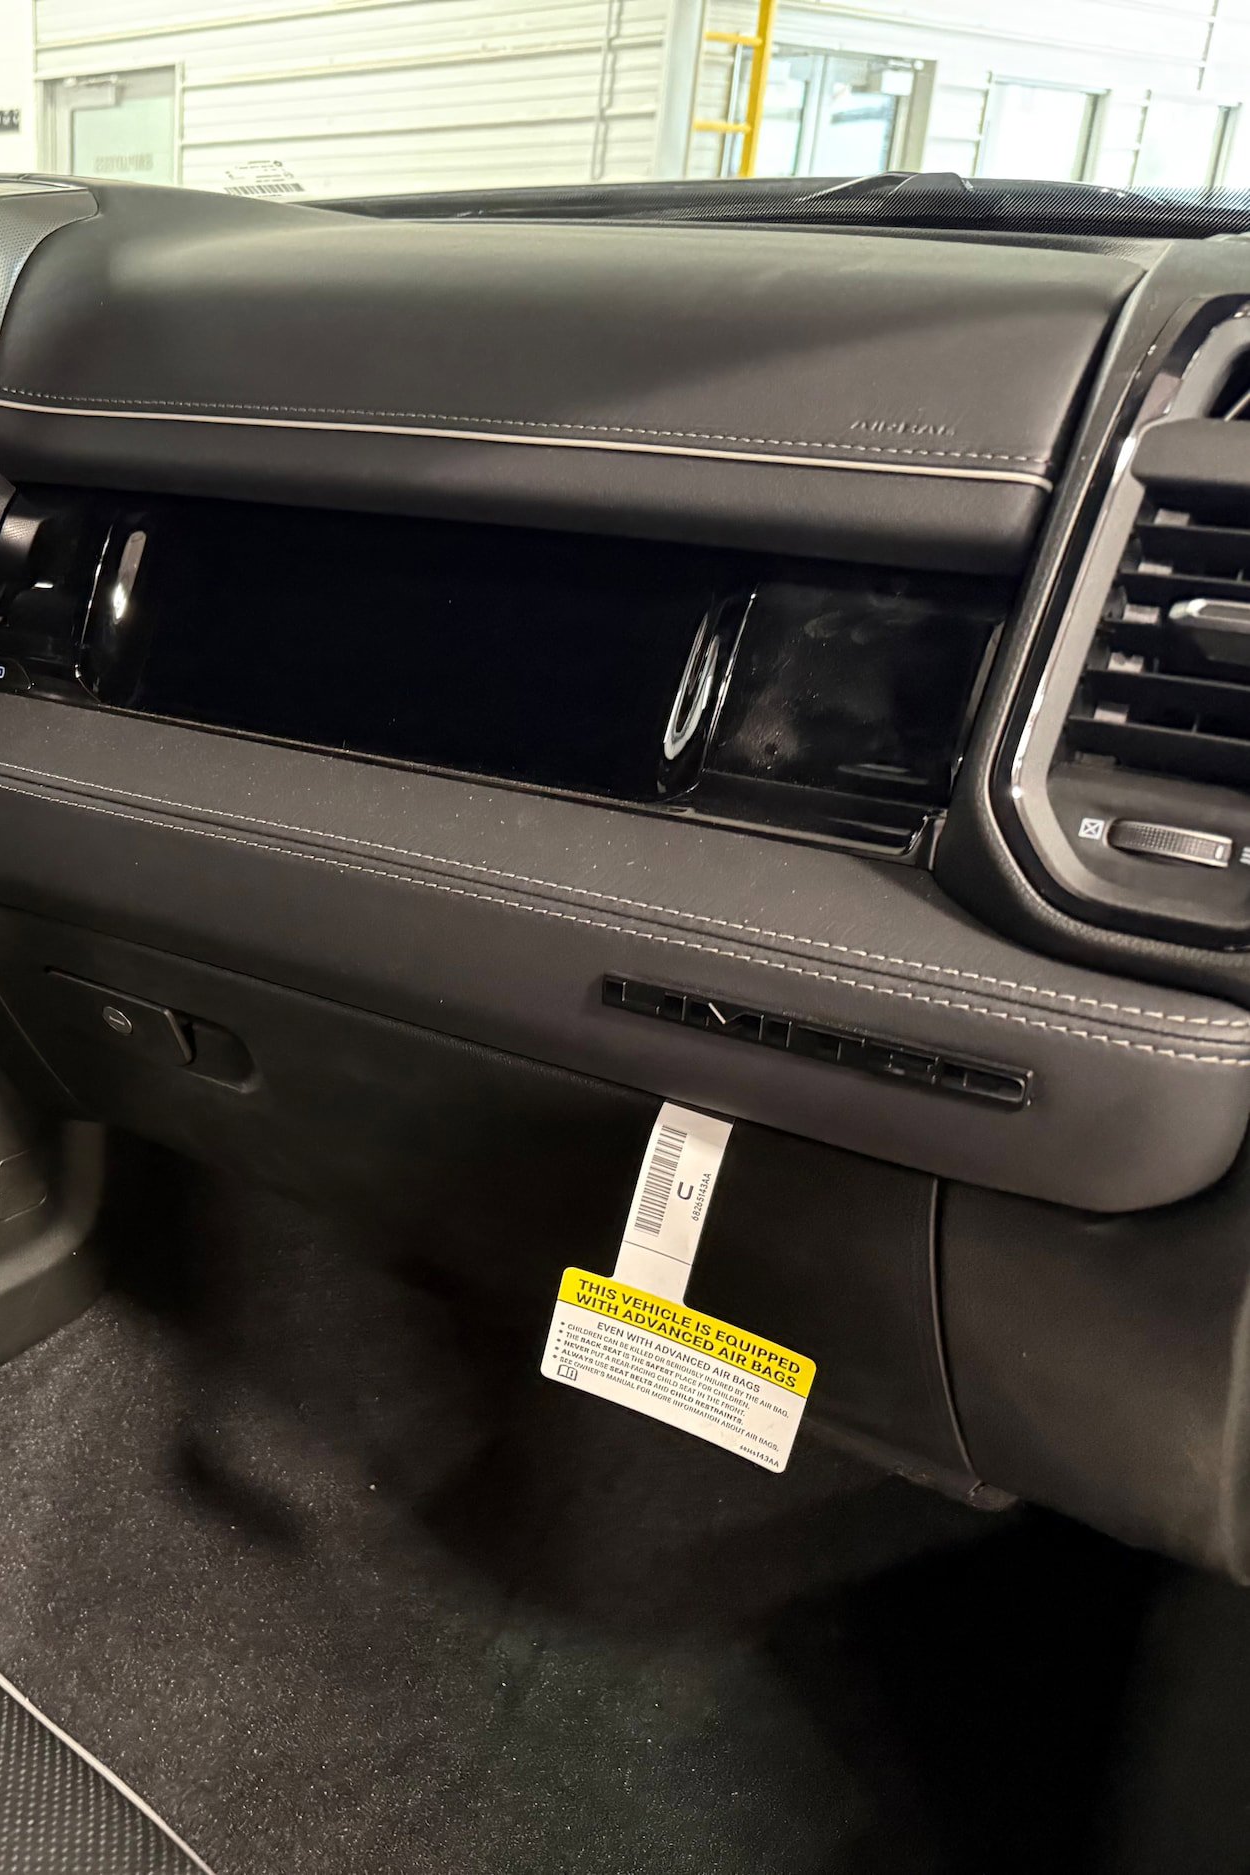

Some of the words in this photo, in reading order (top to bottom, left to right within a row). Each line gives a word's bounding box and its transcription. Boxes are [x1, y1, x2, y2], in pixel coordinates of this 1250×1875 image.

[602, 973, 1035, 1110] LIMITED
[677, 1181, 694, 1200] U
[691, 1172, 712, 1222] 68265143AA
[576, 1291, 619, 1316] WITH
[621, 1309, 715, 1352] ADVANCED
[717, 1346, 748, 1367] AIR
[750, 1359, 797, 1388] BAGS
[578, 1278, 618, 1301] THIS
[621, 1292, 693, 1329] VEHICLE
[694, 1321, 712, 1336] IS
[714, 1329, 801, 1374] EQUIPPED
[596, 1321, 625, 1338] EVEN
[626, 1331, 654, 1349] WITH
[654, 1343, 711, 1371] ADVANCED
[711, 1366, 731, 1381] AIR
[732, 1374, 761, 1393] BAGS
